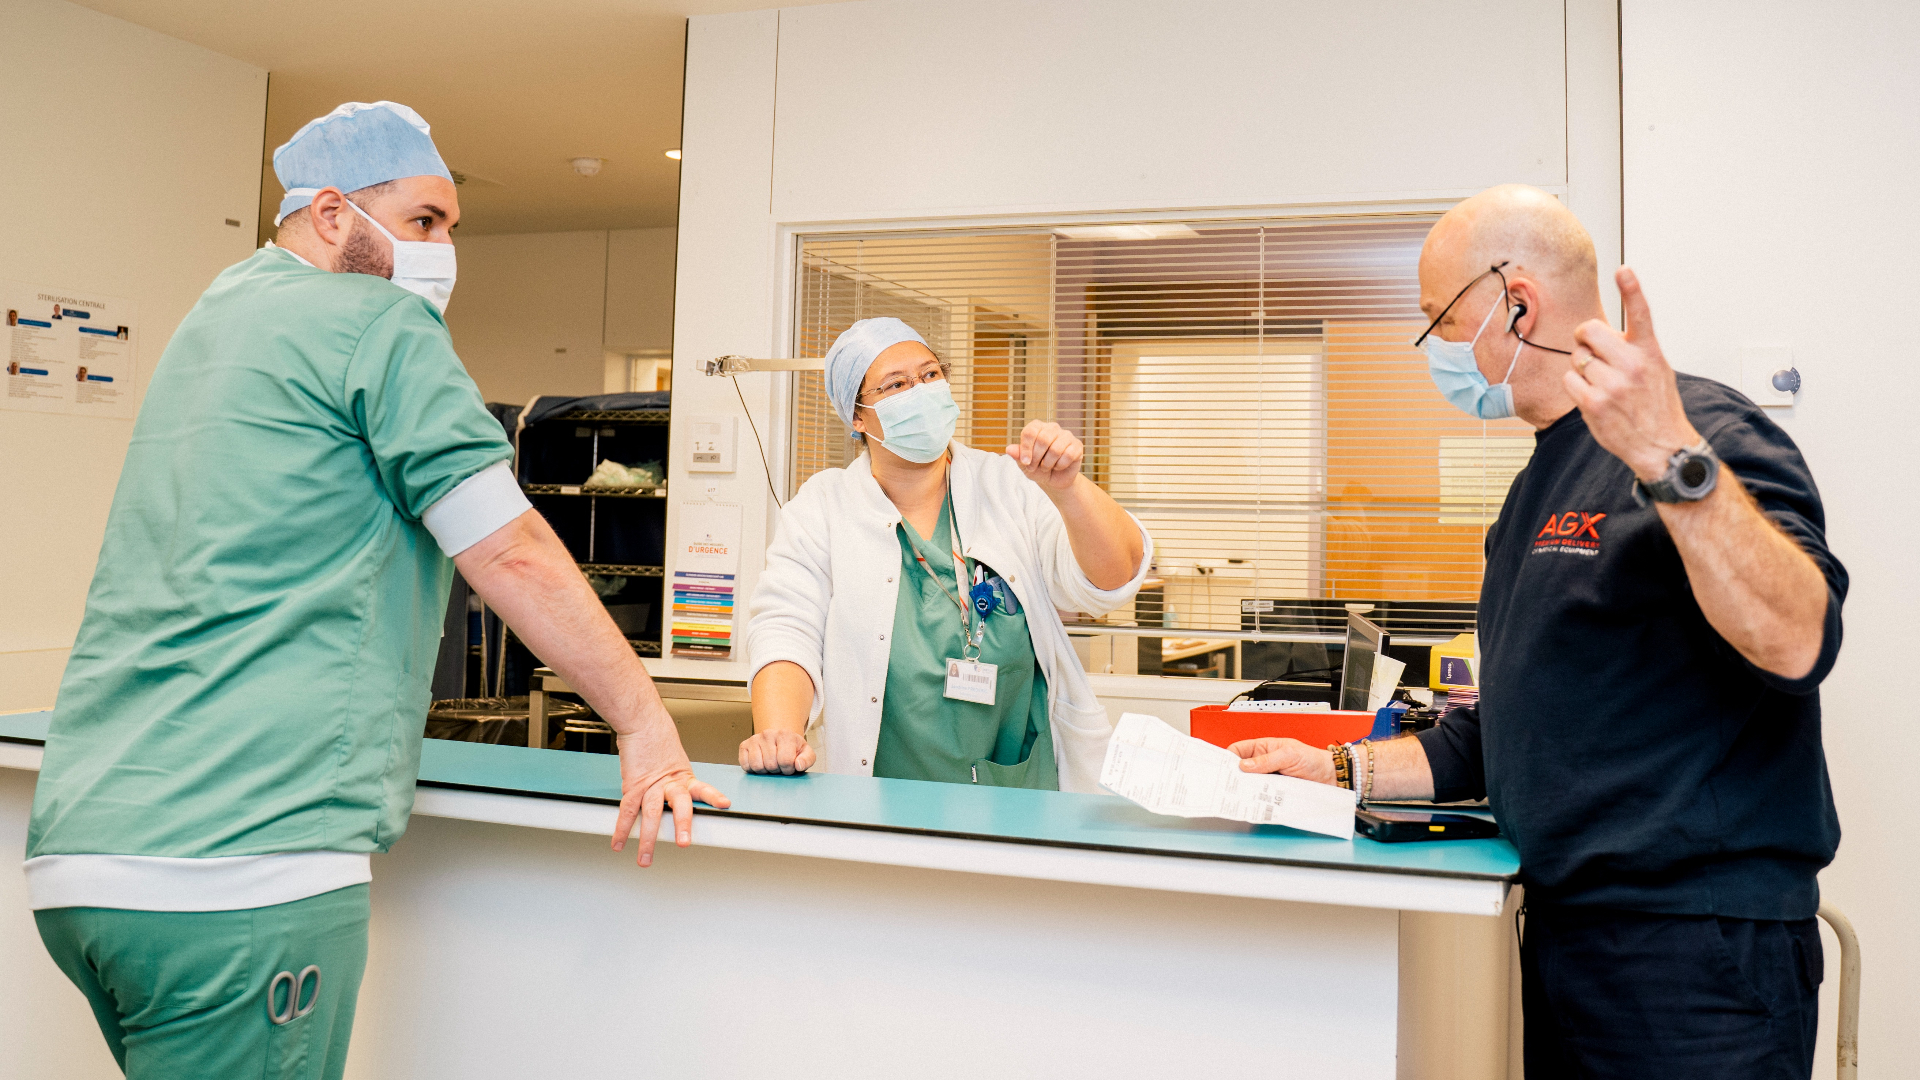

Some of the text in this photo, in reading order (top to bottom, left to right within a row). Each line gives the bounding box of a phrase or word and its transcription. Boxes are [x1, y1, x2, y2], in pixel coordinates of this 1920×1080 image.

[37, 293, 106, 310] STERILISATION CENTRALE
[1537, 511, 1607, 540] AGX
[1561, 538, 1600, 548] DELIVERY
[688, 545, 728, 555] D'URGENCE
